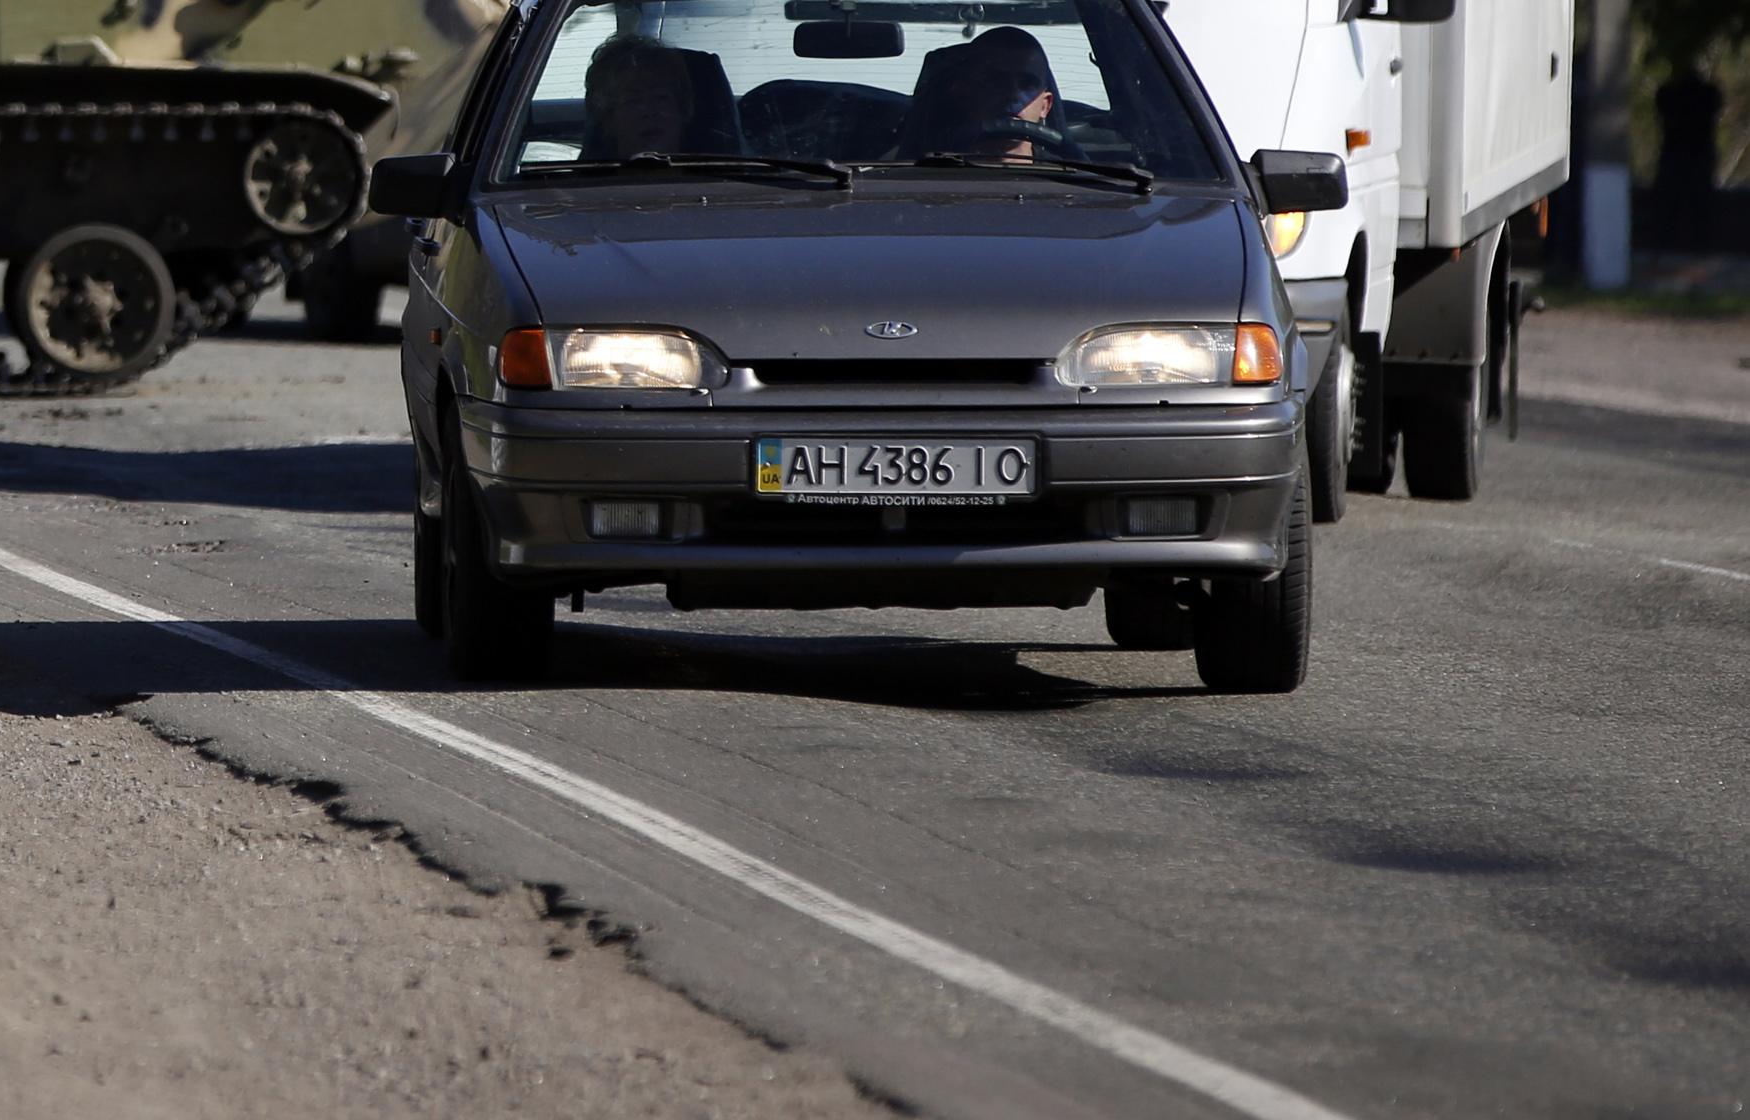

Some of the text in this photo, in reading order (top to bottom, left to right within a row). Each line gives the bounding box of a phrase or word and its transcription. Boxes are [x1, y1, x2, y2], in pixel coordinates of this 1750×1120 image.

[788, 445, 848, 485] AH
[857, 445, 955, 485] 4386
[762, 473, 780, 484] UA
[797, 494, 859, 505] Автоцентр
[862, 496, 925, 505] АВТОСИТИ
